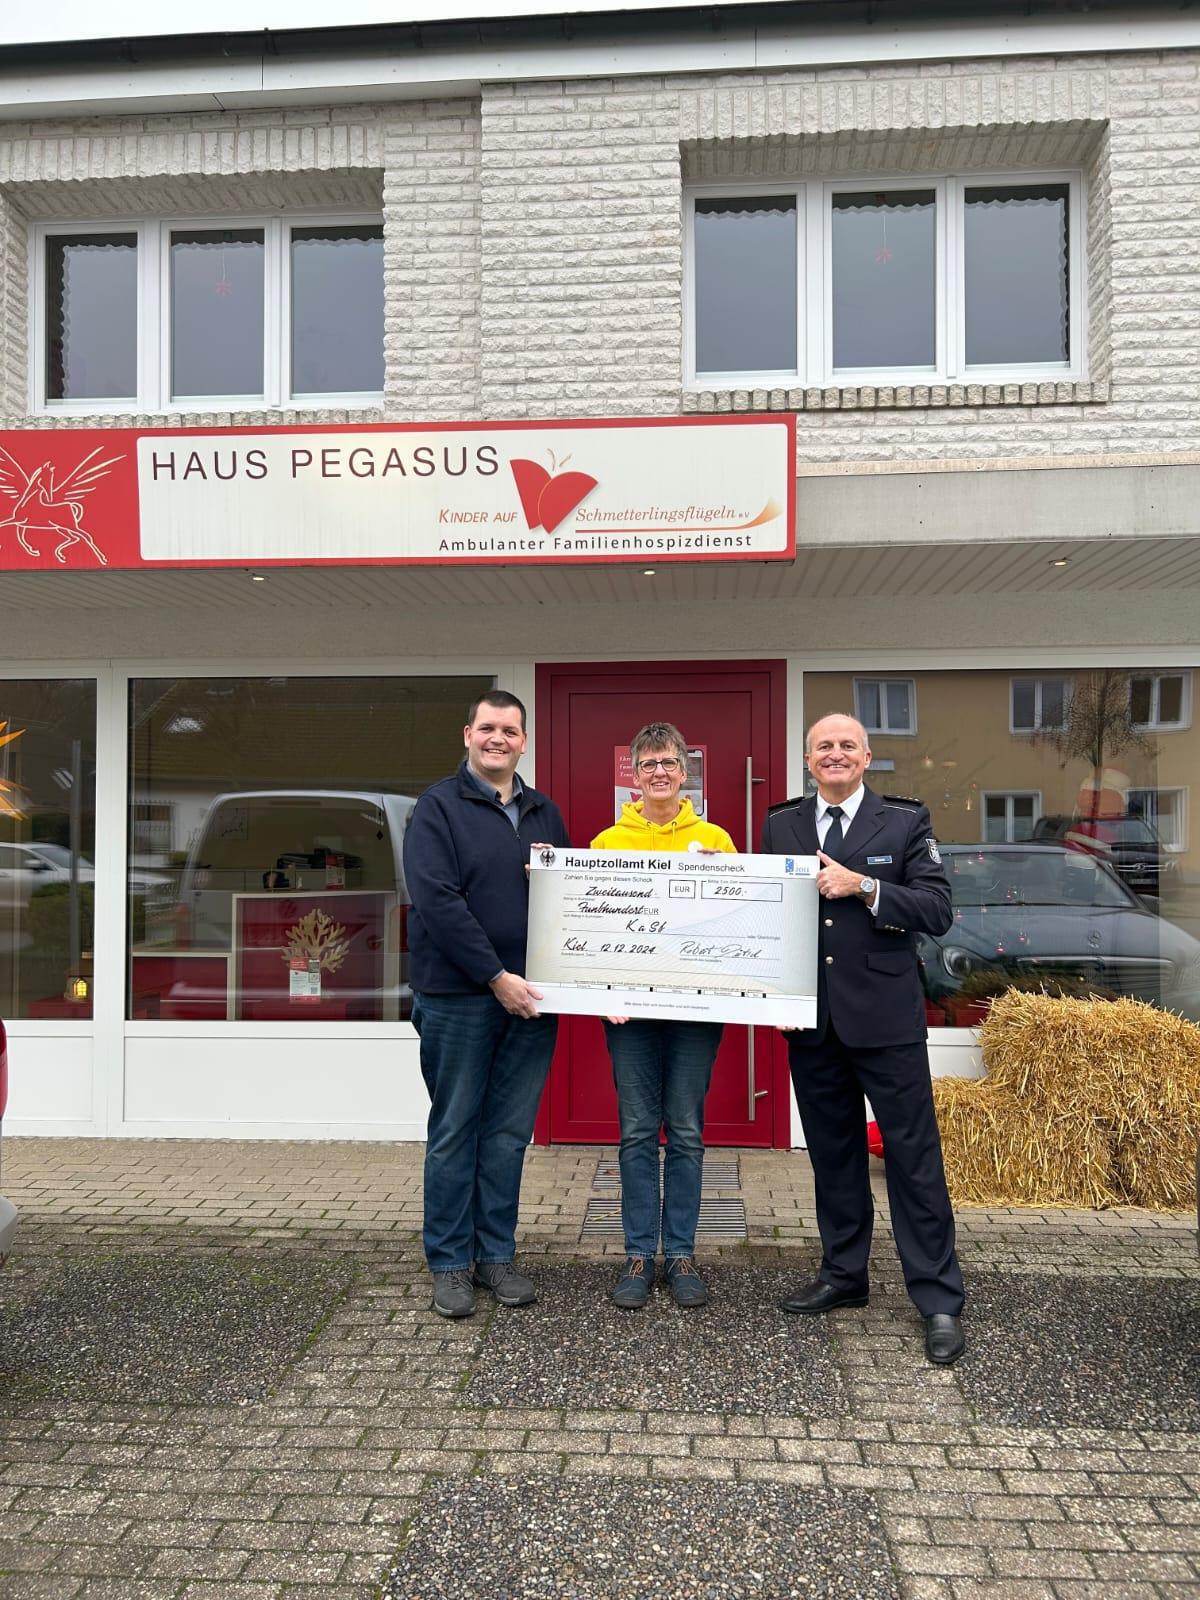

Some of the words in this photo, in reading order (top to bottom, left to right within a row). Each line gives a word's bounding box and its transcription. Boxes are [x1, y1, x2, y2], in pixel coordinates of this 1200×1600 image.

[152, 449, 268, 481] HAUS
[291, 445, 500, 478] PEGASUS
[575, 505, 736, 523] Schmetterlingsflügeln
[439, 538, 546, 551] Ambulanter
[553, 534, 752, 552] Familienhospizdienst
[565, 856, 644, 870] Hauptzollamt
[647, 859, 671, 870] Kiel
[678, 862, 745, 873] Spendenscheck
[644, 907, 659, 915] EUR
[563, 937, 588, 951] Kiel
